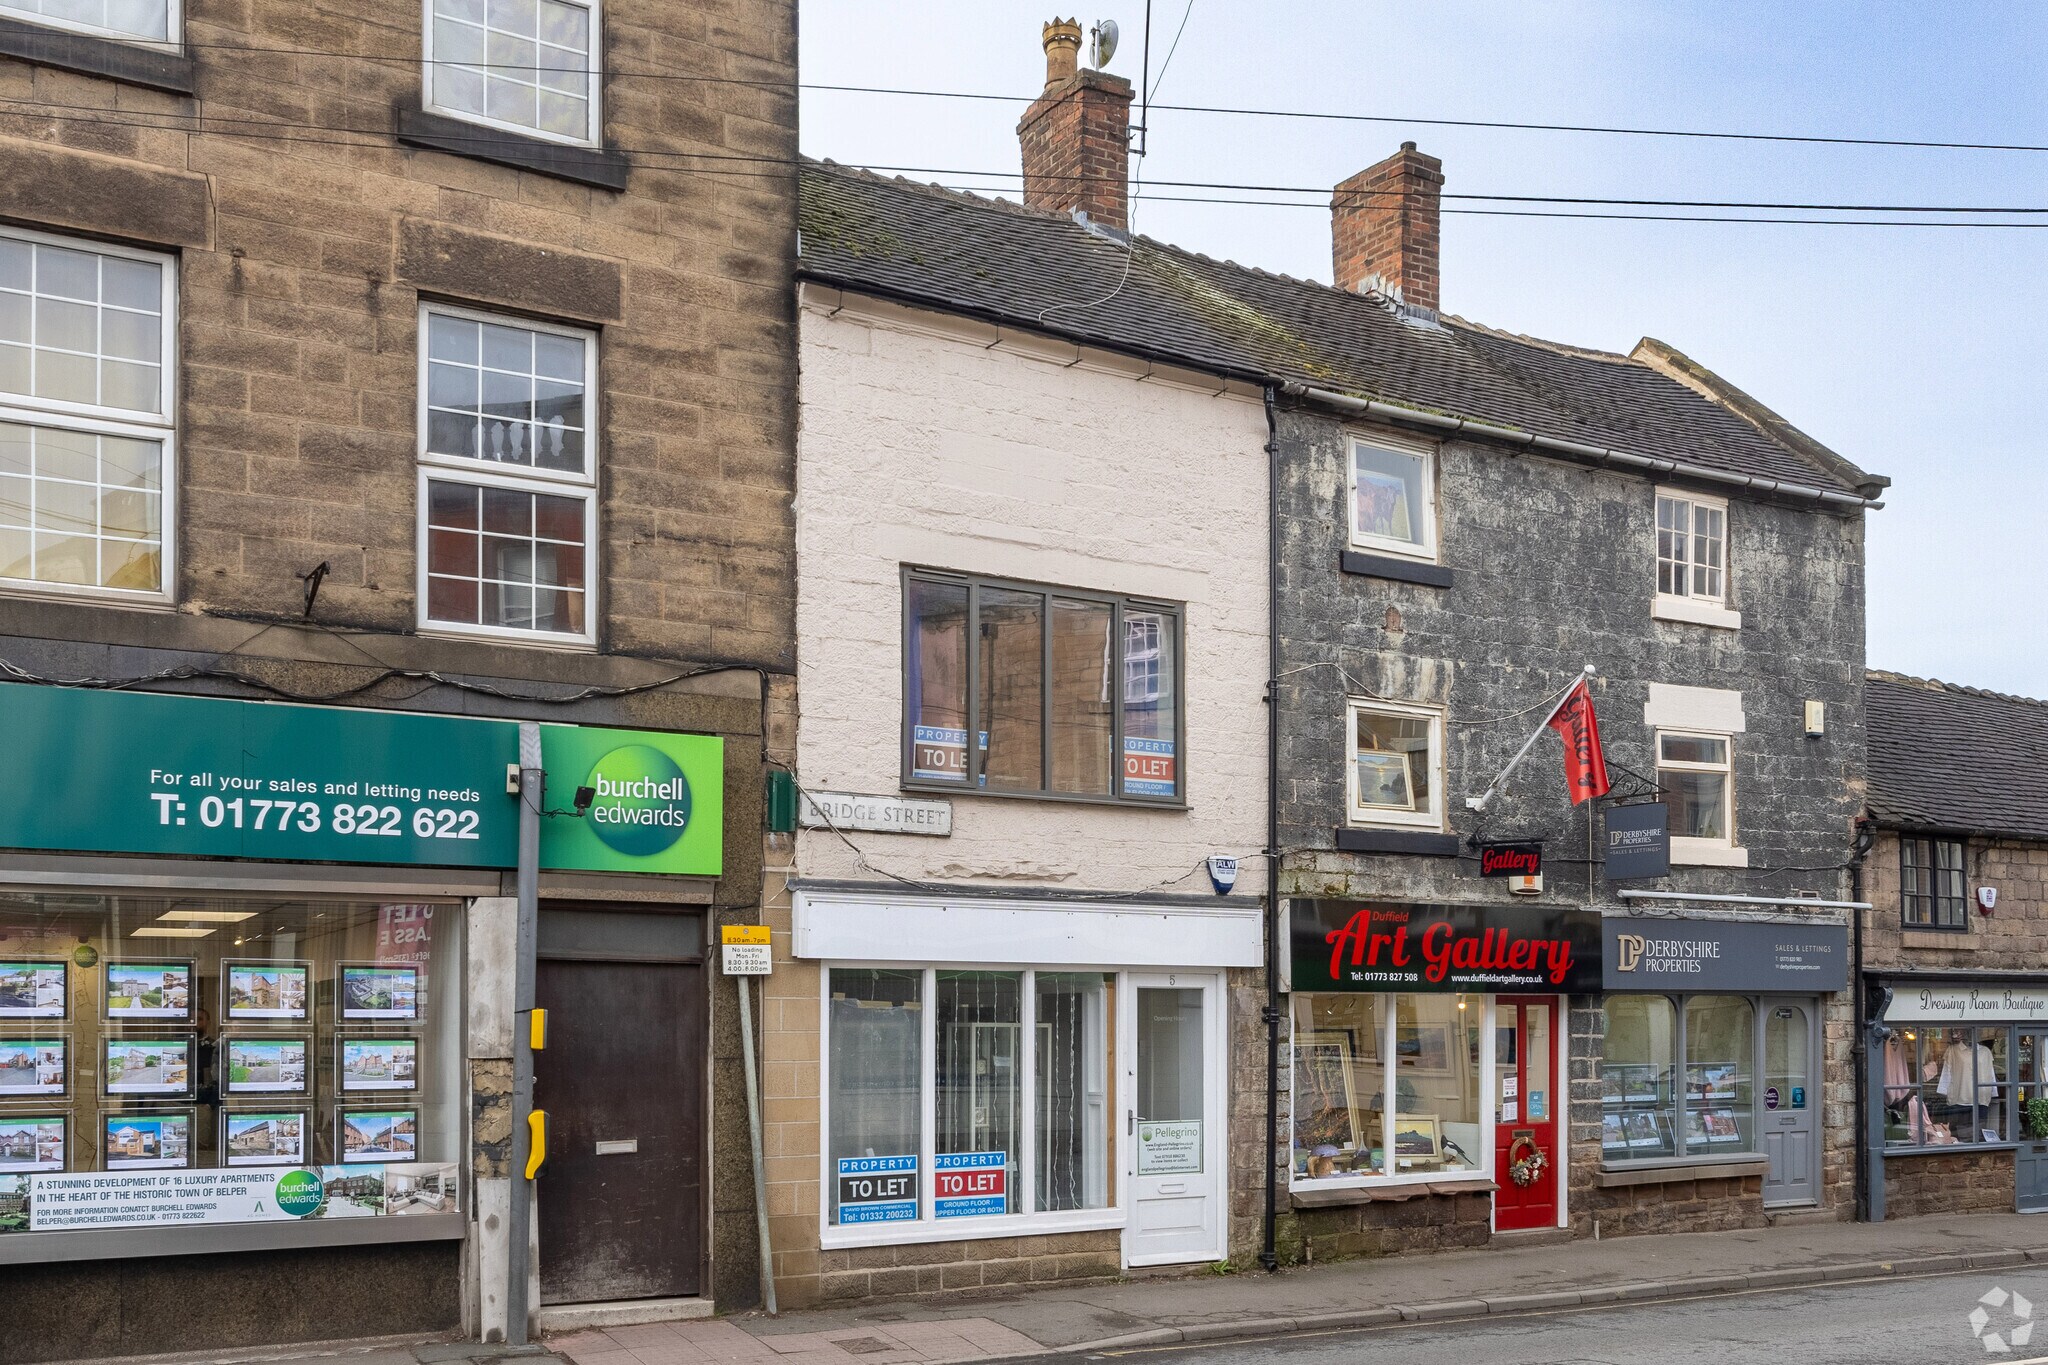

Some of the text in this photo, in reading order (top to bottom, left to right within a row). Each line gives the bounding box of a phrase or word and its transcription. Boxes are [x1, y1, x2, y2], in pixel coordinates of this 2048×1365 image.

[924, 749, 968, 768] TO LE
[1124, 757, 1169, 776] O LET
[150, 770, 480, 802] For all your sales and letting needs
[597, 773, 682, 800] burchell
[150, 792, 480, 840] T: 01773 822 622
[594, 801, 684, 826] edwards
[810, 802, 945, 825] BRIDGE STREET
[1623, 828, 1661, 838] DERBYSHIRE
[1623, 837, 1651, 845] PROPERTIES
[1217, 860, 1235, 868] ALW
[1483, 849, 1538, 874] Gallery
[1372, 911, 1409, 922] Duffield
[1325, 909, 1574, 985] Art Gallery
[1646, 940, 1720, 958] DERBYSHIRE
[1775, 944, 1793, 952] SALES
[1801, 945, 1831, 953] LETTINGS
[1646, 958, 1701, 973] PROPERTIES
[1169, 974, 1176, 986] 5
[1350, 972, 1543, 984] Tel: 01773 827 508 www.duffieldartgallery.co.uk
[1920, 989, 2044, 1018] Dressing Room Boutique
[1155, 1127, 1198, 1139] Pellegrino
[841, 1159, 913, 1171] PROPERTY
[935, 1155, 1002, 1167] PROPERTY
[37, 1173, 275, 1189] A STUNNING DEVELOPMENT OF 16 LUXURY APARTMENTS
[280, 1182, 320, 1193] burchell
[849, 1178, 908, 1198] TO LET
[941, 1174, 997, 1192] TO LET
[37, 1187, 247, 1202] IN THE HEART OF THE HISTORIC TOWN OF BELPER
[279, 1193, 320, 1204] edwards
[74, 1206, 118, 1215] INFORMATION
[152, 1204, 184, 1212] BURCHELL
[186, 1203, 217, 1211] EDWARDS
[843, 1209, 913, 1222] Tel: 01332 200232
[37, 1213, 156, 1225] BELPER@BURCHELLEDWARDS.CO.UK
